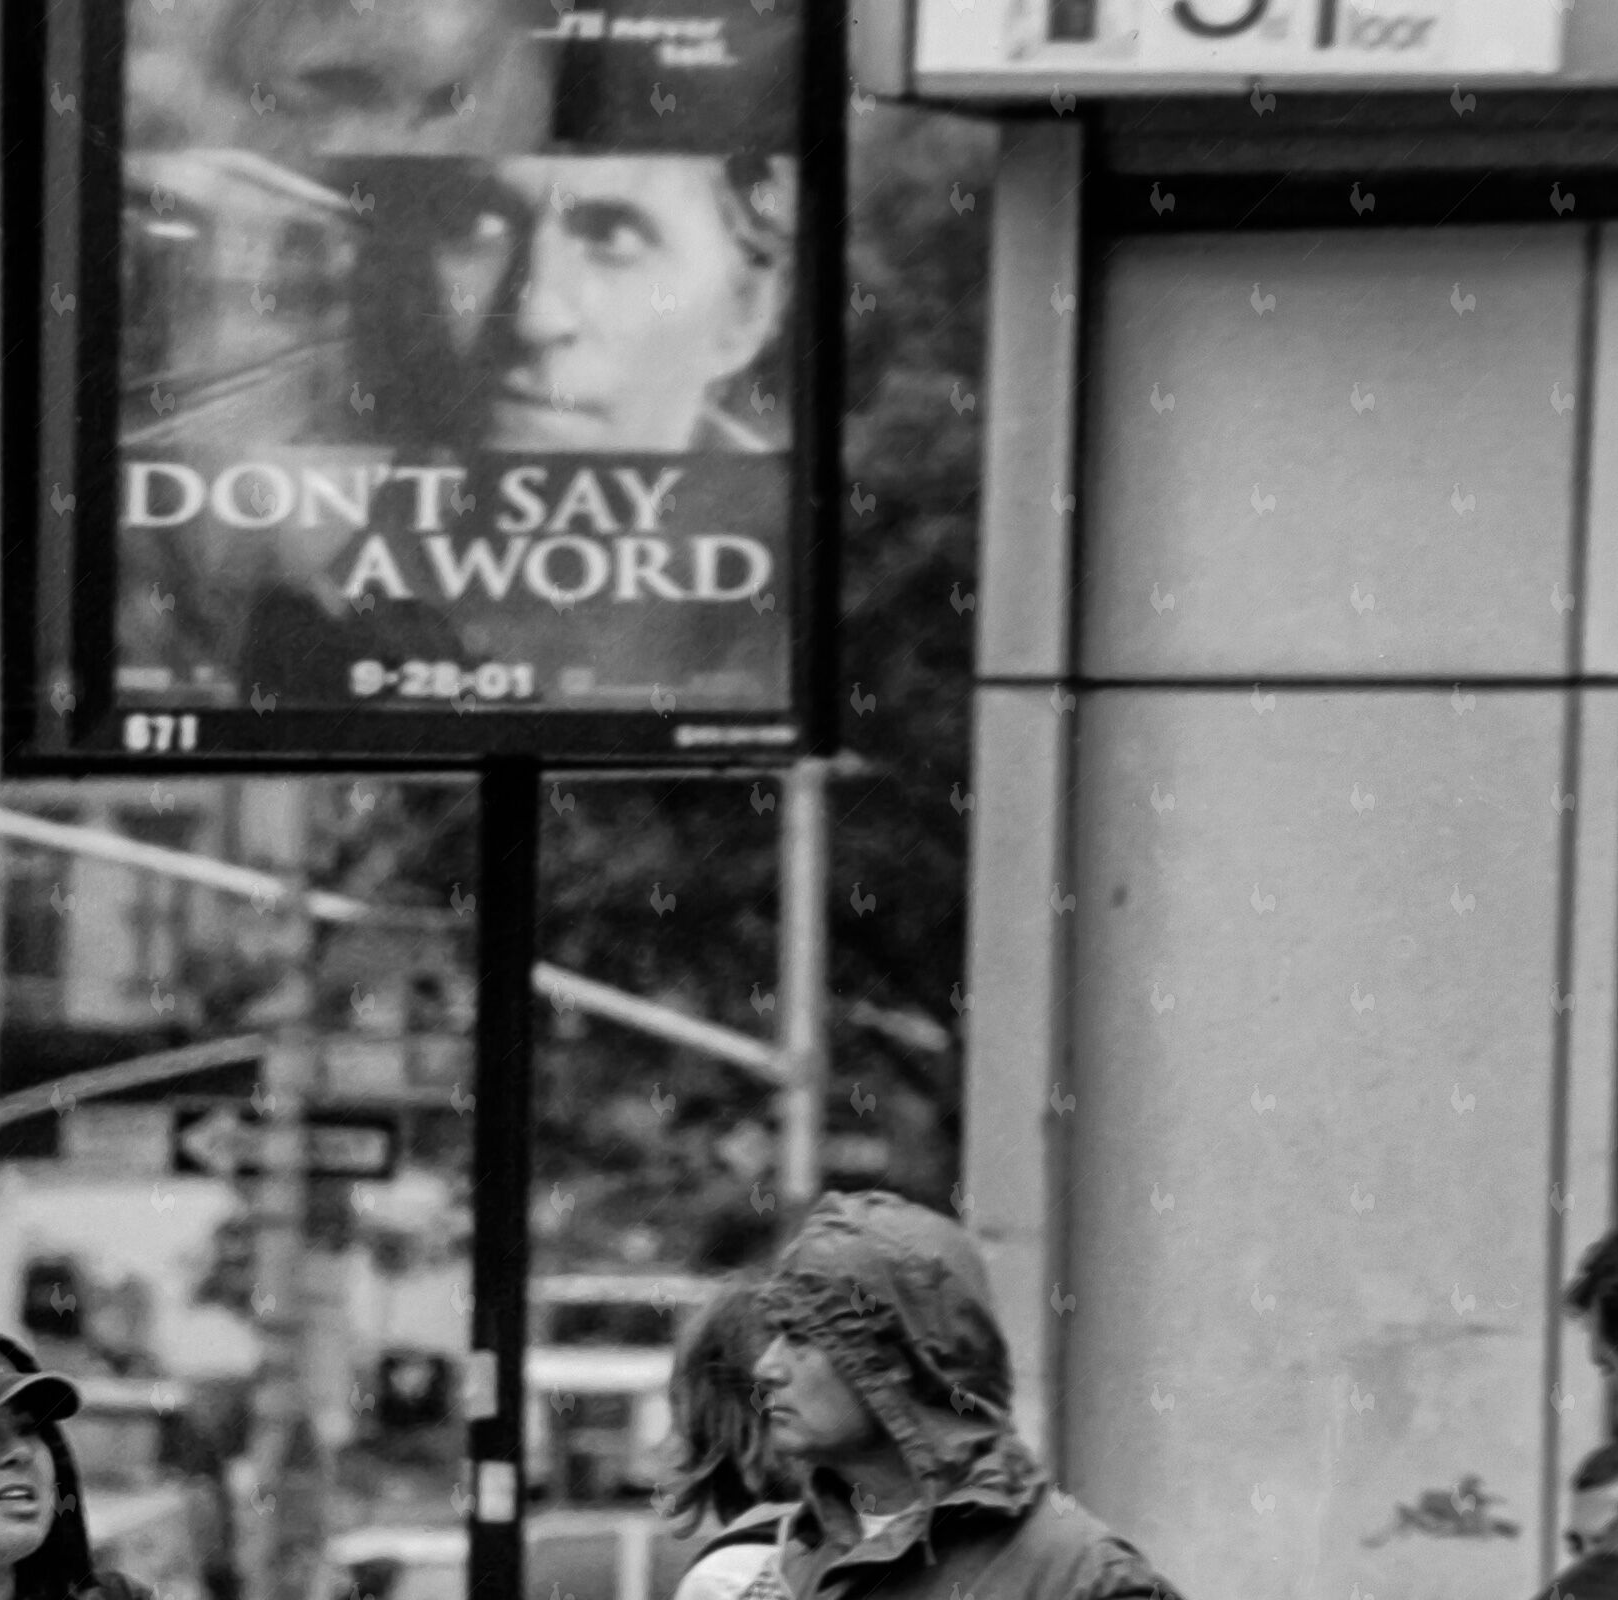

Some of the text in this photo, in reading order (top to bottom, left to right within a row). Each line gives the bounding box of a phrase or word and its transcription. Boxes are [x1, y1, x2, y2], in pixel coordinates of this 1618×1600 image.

[123, 461, 685, 534] DON'T SAY
[341, 533, 774, 602] A WORD
[348, 659, 535, 700] 9-28-01
